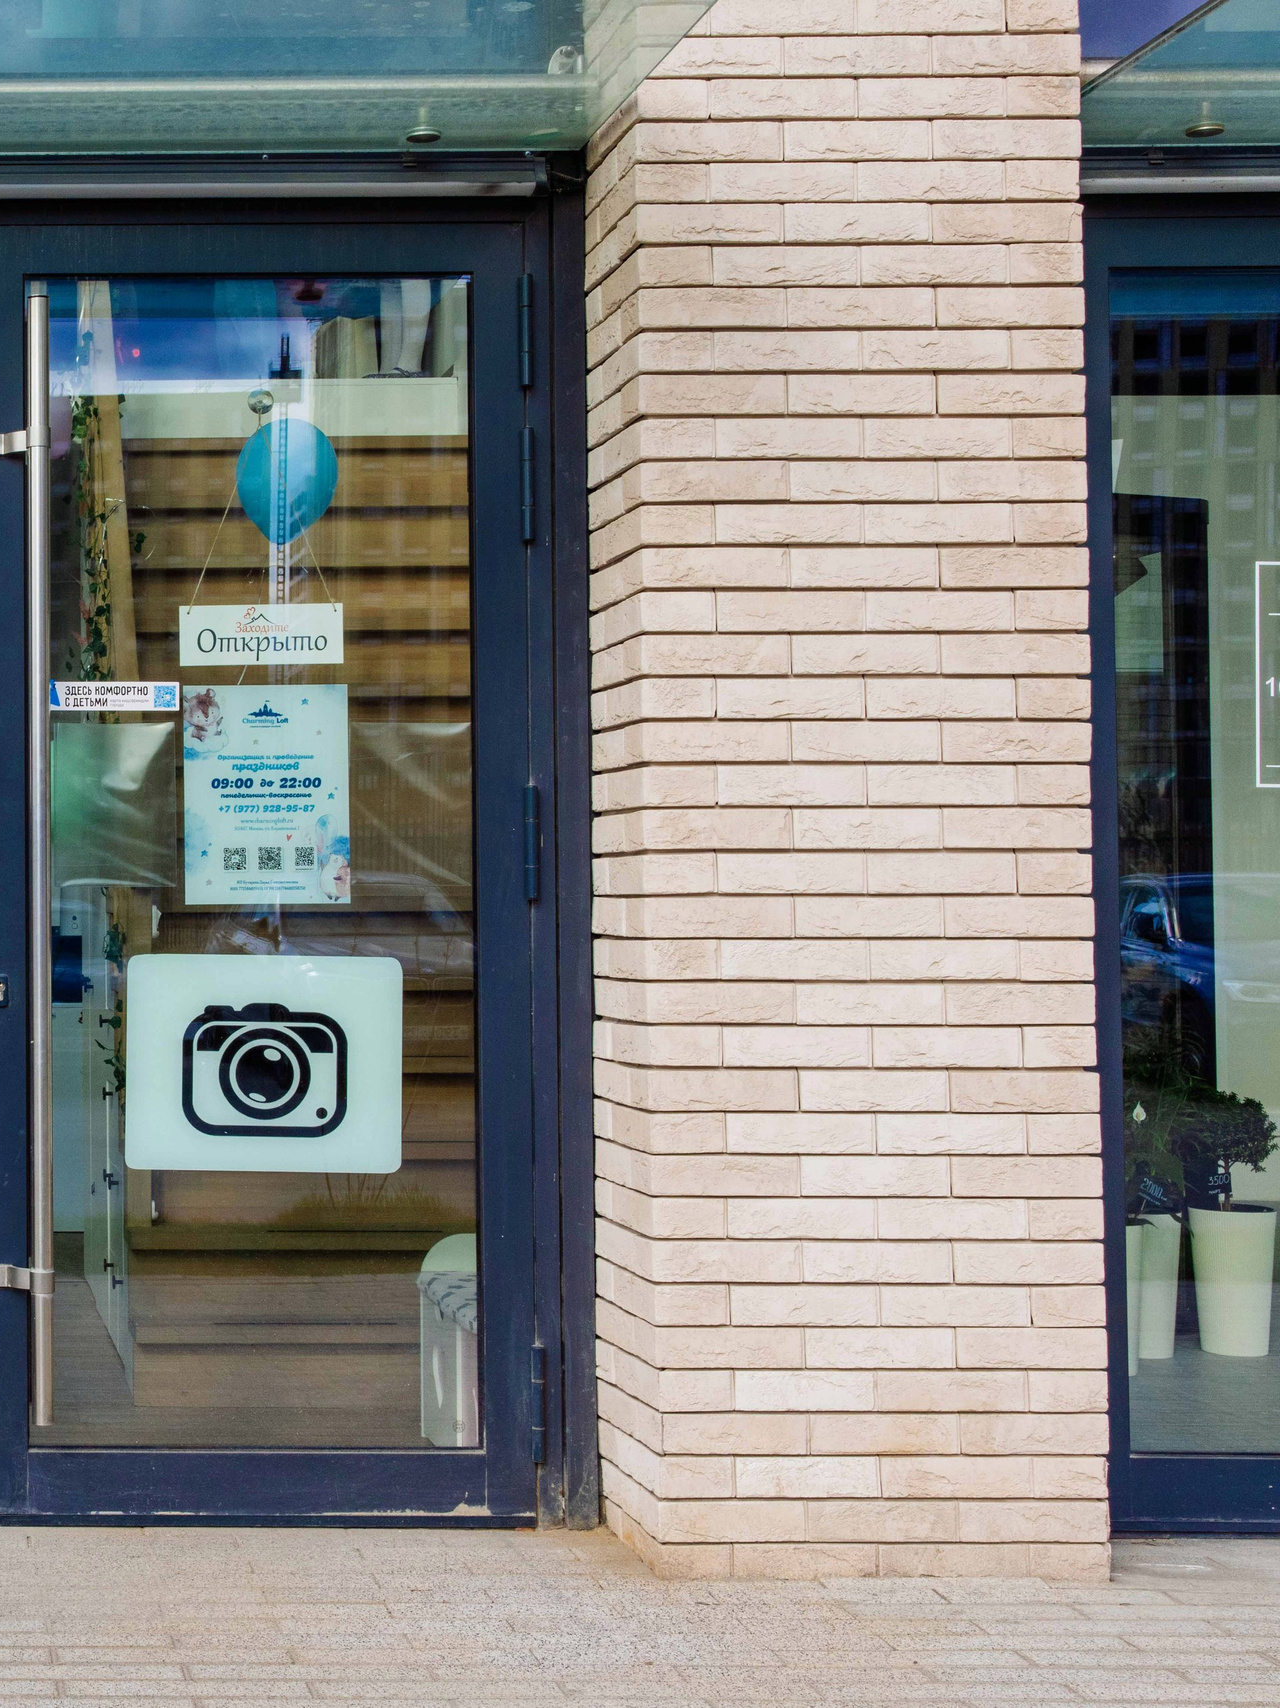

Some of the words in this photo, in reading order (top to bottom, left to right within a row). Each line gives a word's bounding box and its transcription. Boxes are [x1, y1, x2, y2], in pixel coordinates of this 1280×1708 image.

[235, 621, 289, 635] Заходите
[197, 628, 328, 661] Открыто
[64, 686, 92, 696] ЗДЕСЬ
[95, 685, 149, 696] КОМФОРТНО
[1266, 676, 1280, 697] 1
[64, 697, 70, 708] С
[73, 697, 108, 708] ДЕТЬМИ
[232, 762, 300, 772] праздников
[211, 778, 254, 789] 09:00
[260, 779, 275, 787] до
[279, 777, 322, 788] 22:00
[218, 805, 231, 813] +7
[233, 804, 260, 813] (977)
[262, 804, 315, 813] 928-95-87
[1208, 1174, 1230, 1185] 3500
